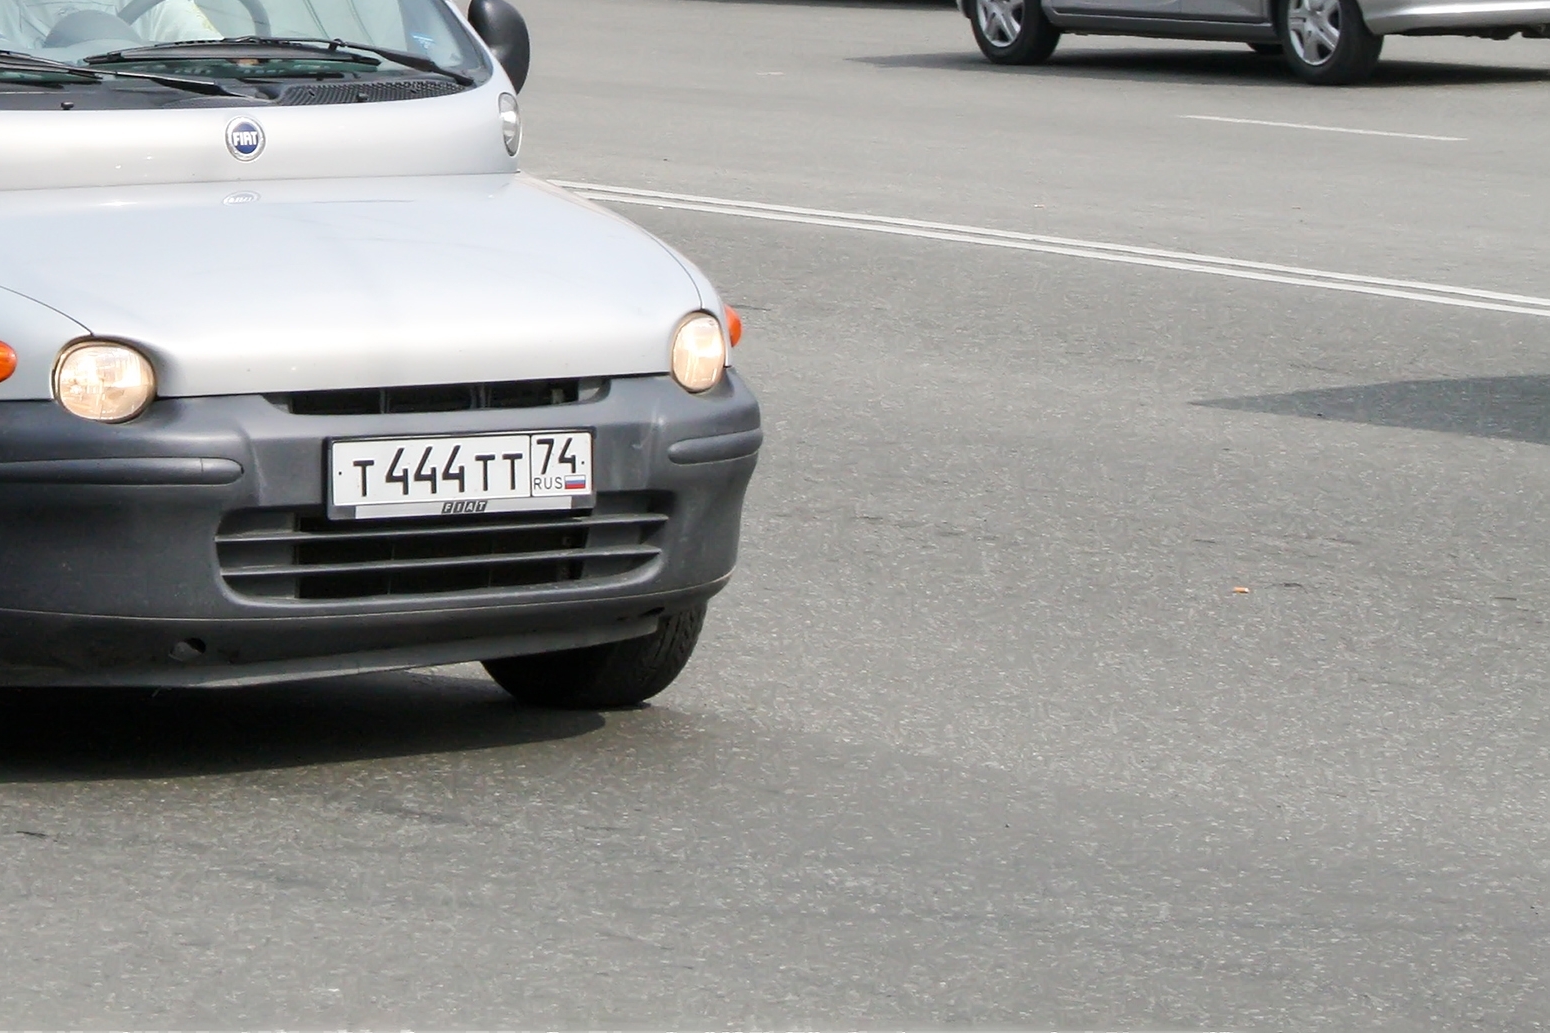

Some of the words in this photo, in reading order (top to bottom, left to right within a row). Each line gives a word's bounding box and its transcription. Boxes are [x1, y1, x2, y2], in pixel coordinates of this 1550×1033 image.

[233, 131, 258, 146] FIAT
[537, 438, 576, 474] 74
[534, 477, 563, 490] RUS
[441, 500, 488, 514] FIAT
